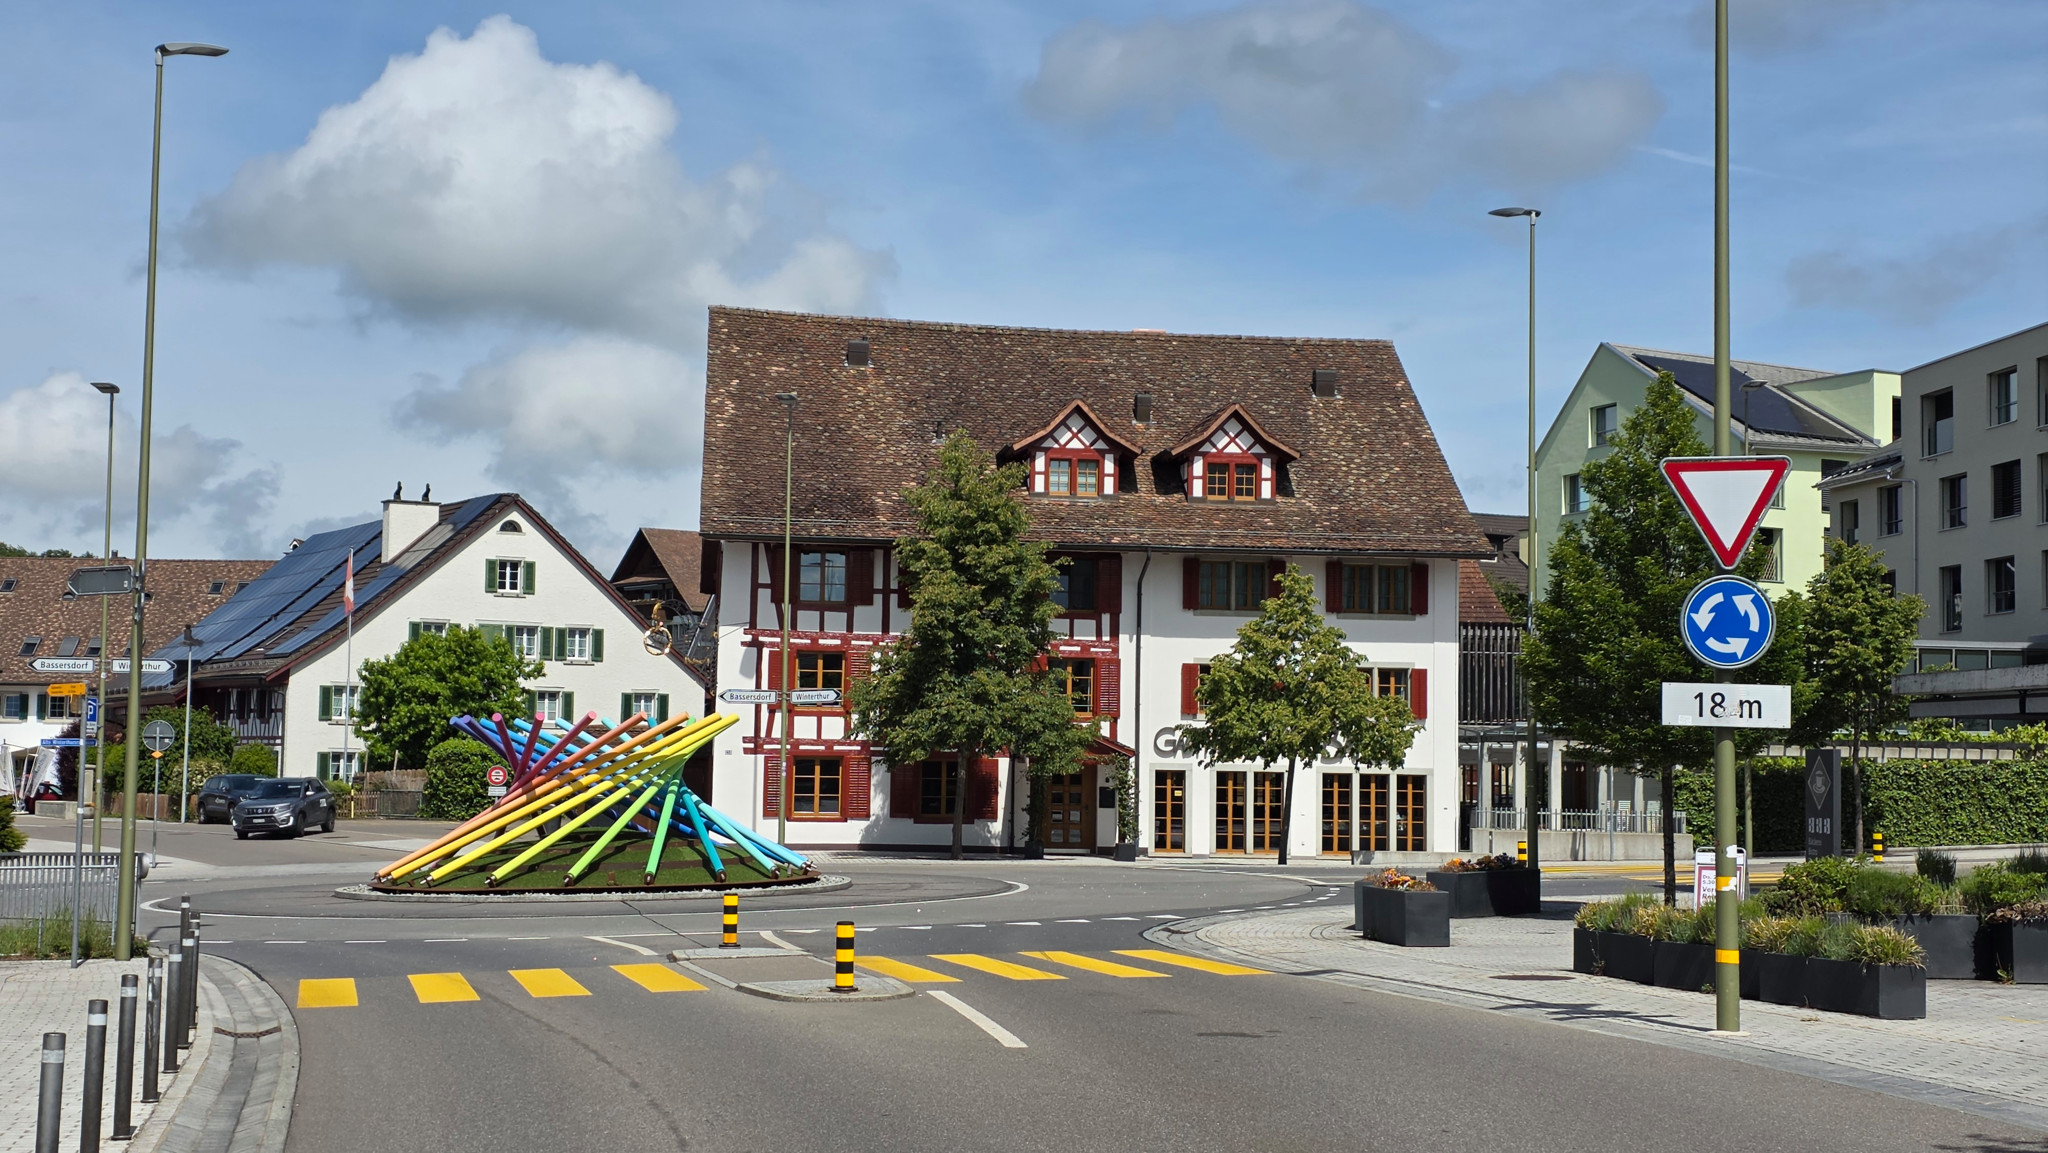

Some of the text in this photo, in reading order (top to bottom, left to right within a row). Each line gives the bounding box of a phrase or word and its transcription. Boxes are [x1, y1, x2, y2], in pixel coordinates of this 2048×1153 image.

[40, 659, 88, 669] Bassersdorf
[118, 660, 162, 670] Wirthur
[729, 692, 772, 701] Bassersdorf
[795, 692, 830, 701] Winterthur
[1693, 692, 1762, 719] 18 m
